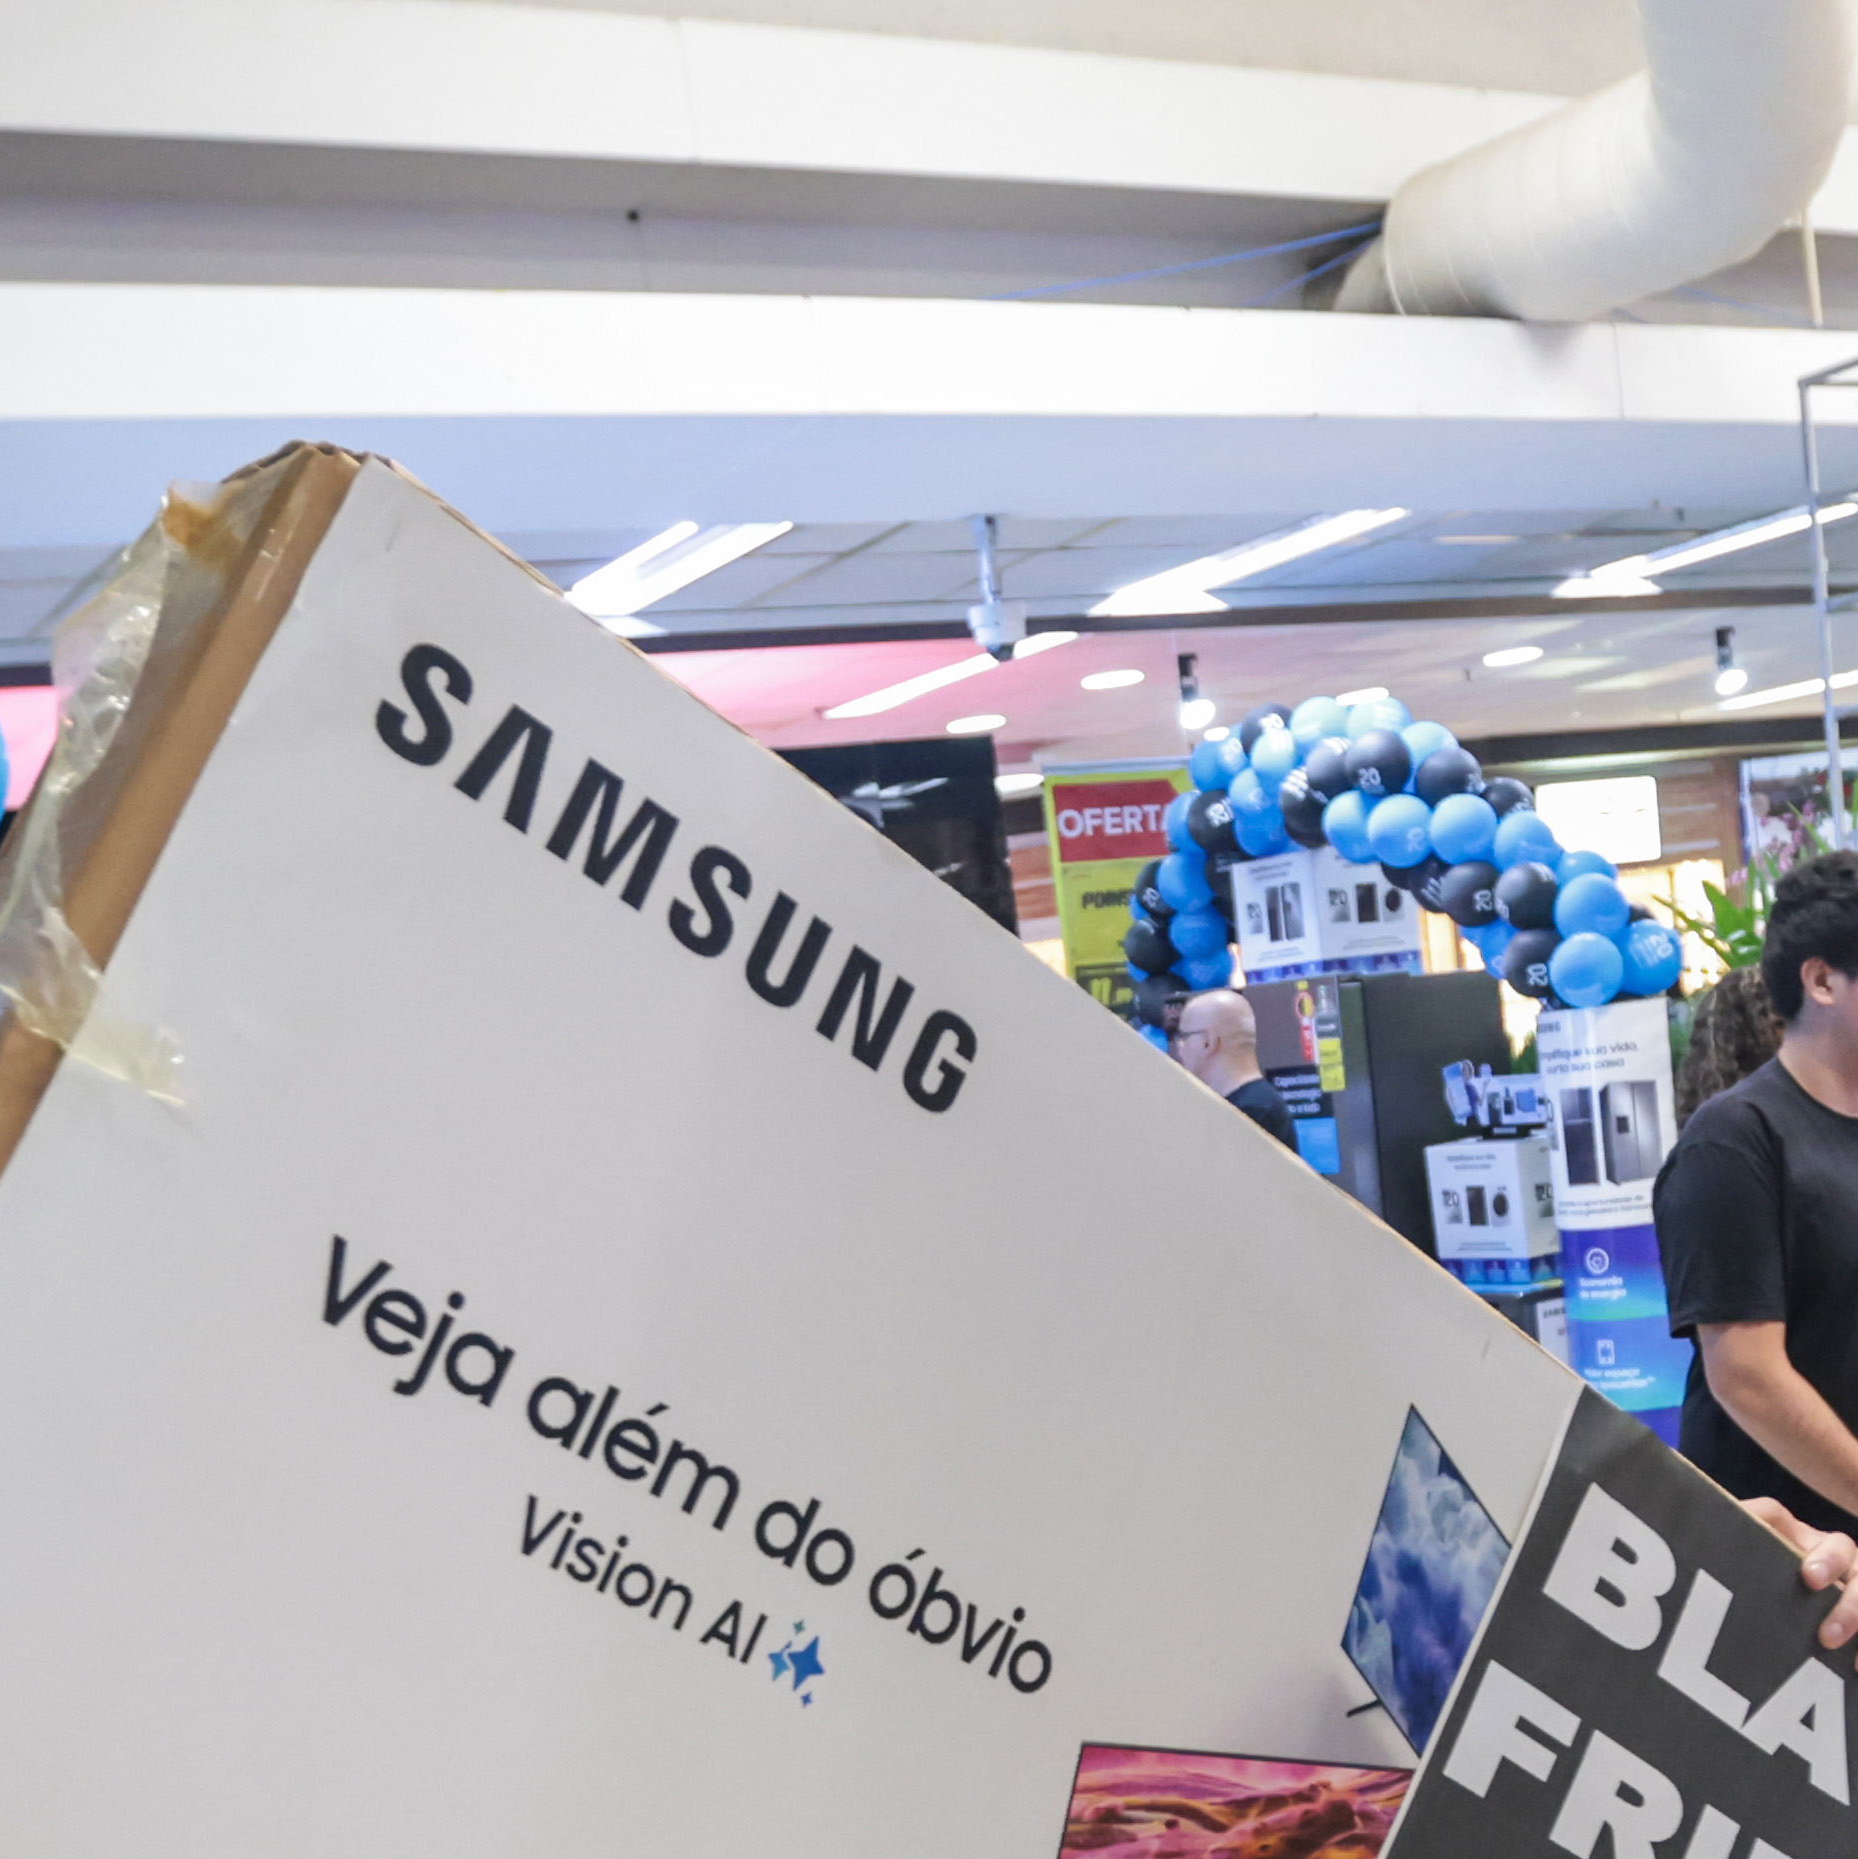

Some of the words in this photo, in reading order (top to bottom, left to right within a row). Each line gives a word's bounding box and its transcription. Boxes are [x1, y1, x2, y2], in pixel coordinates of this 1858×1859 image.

[375, 643, 978, 1114] SAMSUNG
[1358, 766, 1381, 787] 20
[322, 1234, 516, 1406] Veja
[525, 1375, 741, 1531] além
[754, 1498, 856, 1586] do
[868, 1548, 1053, 1695] óbvio
[520, 1494, 693, 1631] Vision
[701, 1600, 767, 1664] AI
